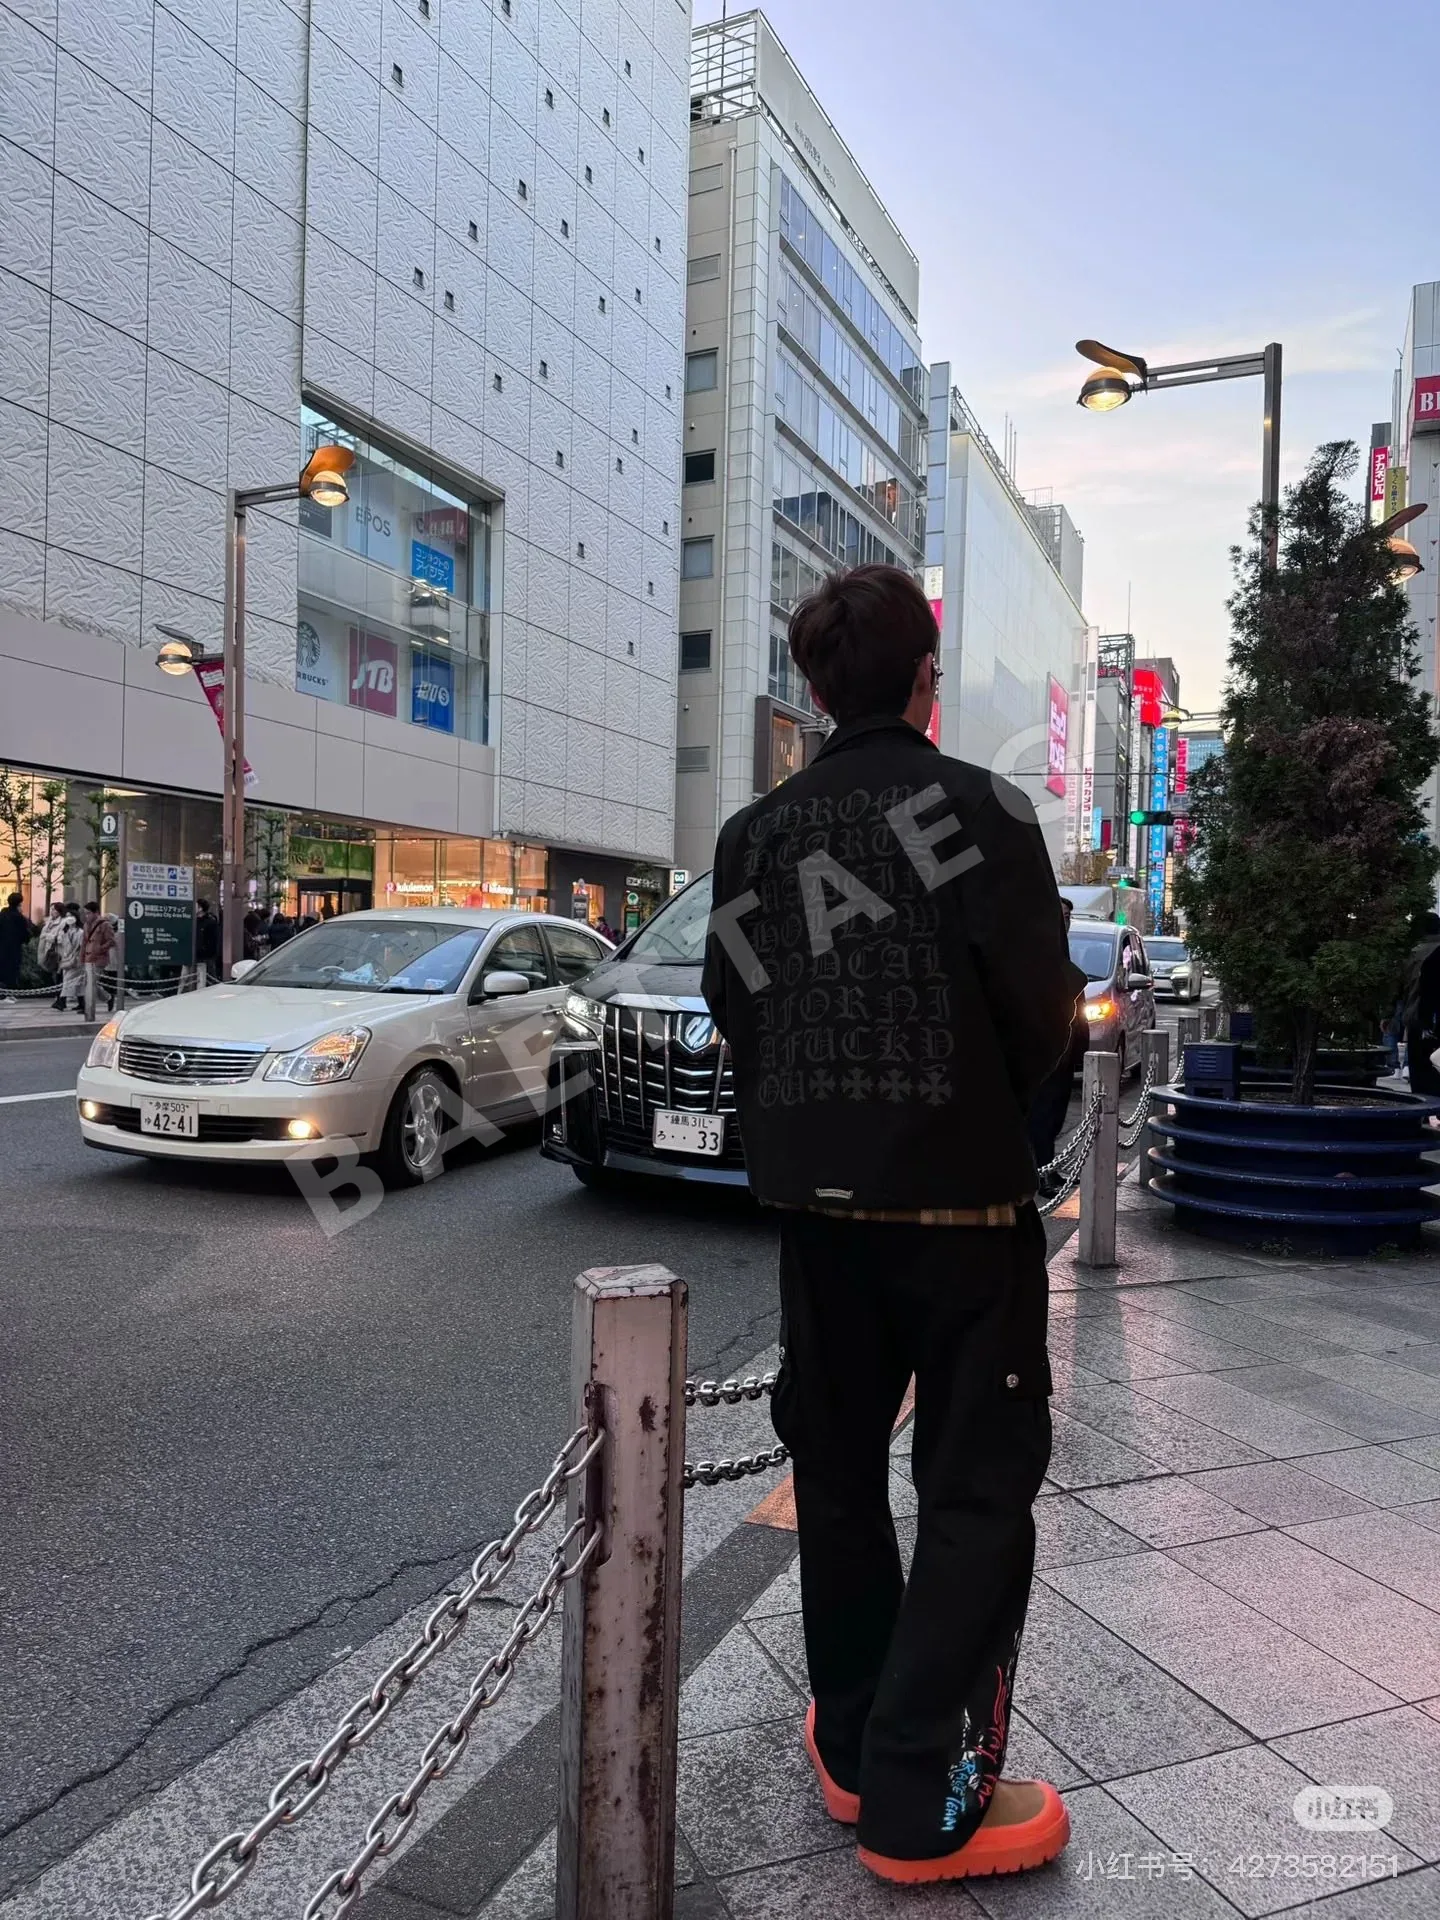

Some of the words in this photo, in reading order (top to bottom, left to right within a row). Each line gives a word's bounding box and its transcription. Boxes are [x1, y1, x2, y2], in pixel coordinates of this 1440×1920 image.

[355, 505, 391, 538] EPOS
[352, 659, 394, 694] JTB
[396, 881, 434, 893] lululemon
[153, 1113, 193, 1134] 42-41
